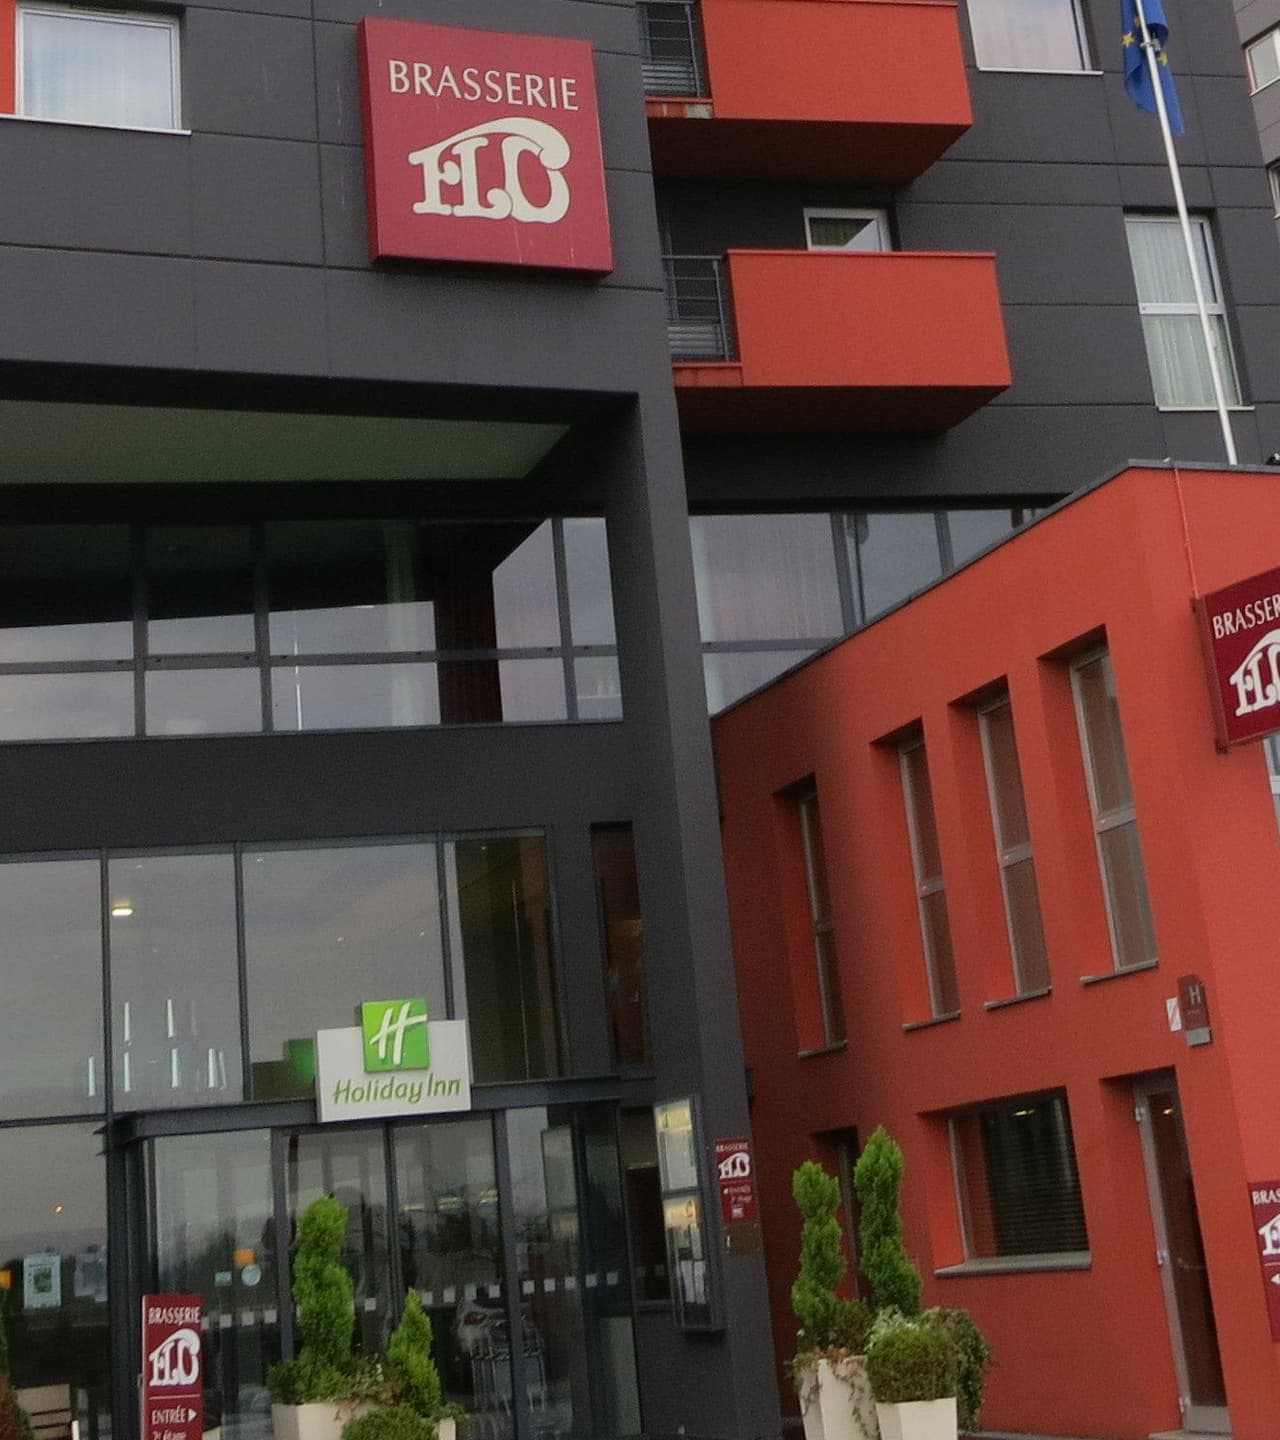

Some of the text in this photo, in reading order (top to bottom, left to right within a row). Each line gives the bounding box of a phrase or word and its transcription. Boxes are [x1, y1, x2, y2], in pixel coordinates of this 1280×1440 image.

[388, 59, 579, 111] BRASSERIE
[408, 116, 571, 224] FLO
[333, 1072, 462, 1104] Holiday Inn
[148, 1306, 201, 1325] BRASSERIE
[148, 1327, 201, 1387] FLO
[151, 1404, 186, 1425] ENTRÉE
